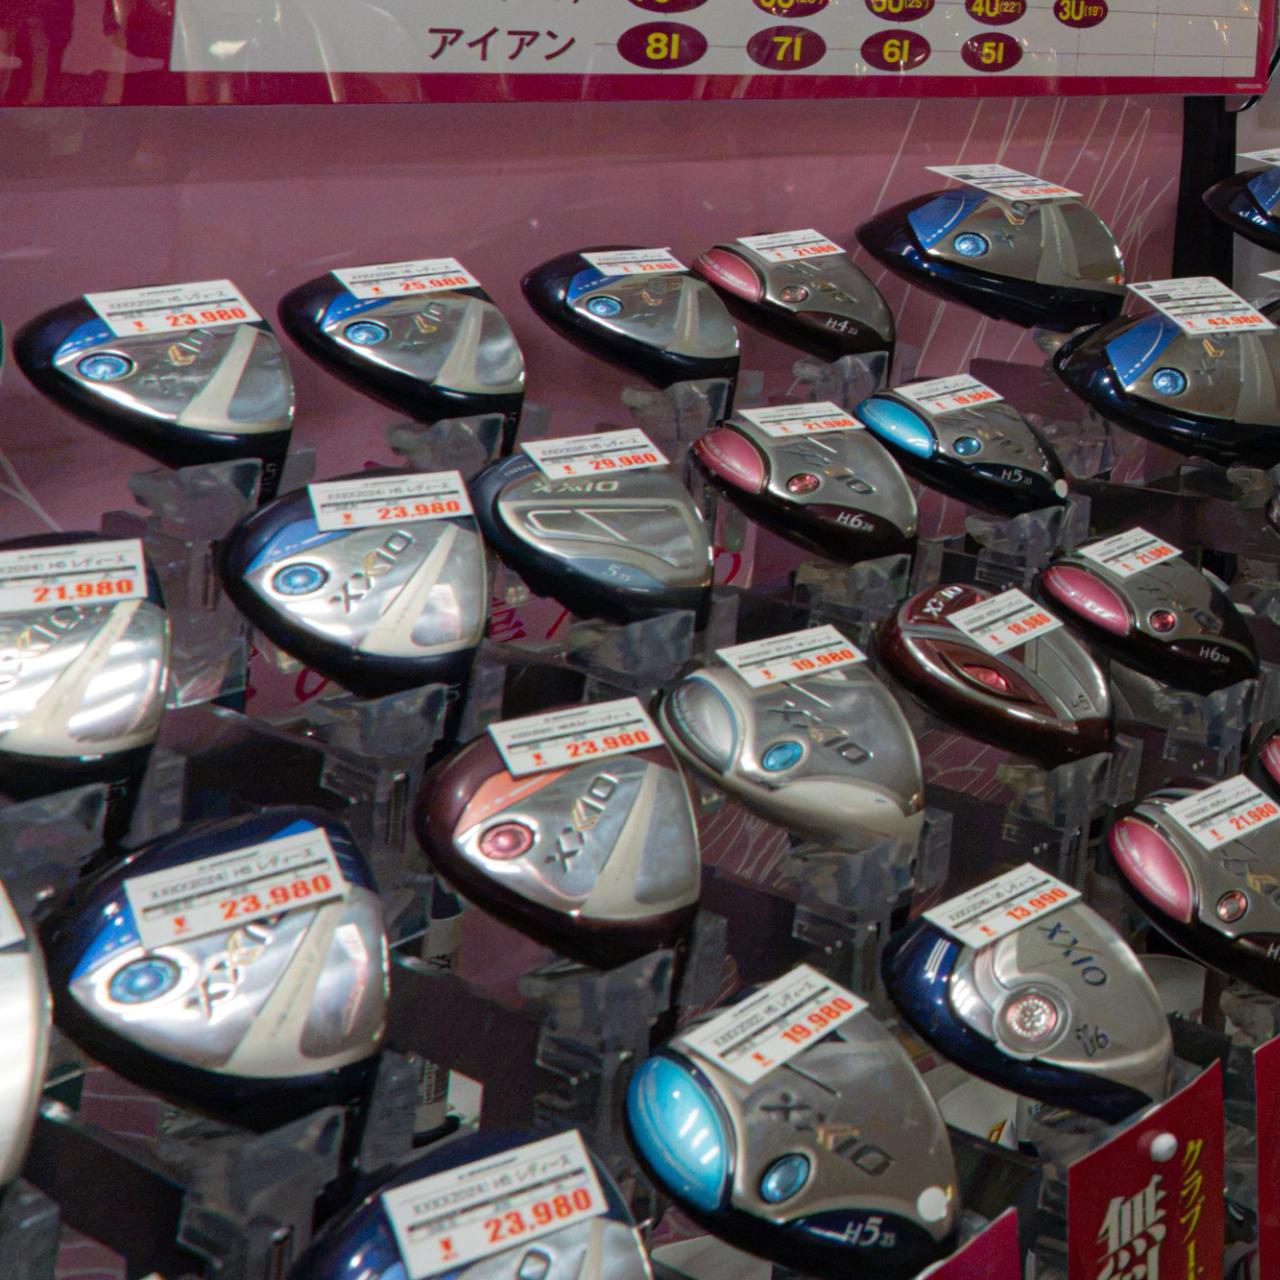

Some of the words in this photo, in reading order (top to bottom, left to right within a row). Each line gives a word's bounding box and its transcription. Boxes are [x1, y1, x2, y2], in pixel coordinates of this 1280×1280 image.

[426, 26, 577, 62] アイアン
[165, 306, 247, 328] 23,980
[827, 316, 849, 332] H4
[1001, 468, 1023, 483] H5
[377, 499, 462, 522] 23,980
[838, 511, 862, 528] H6
[33, 579, 134, 604] 21,980
[1200, 646, 1220, 660] H6
[565, 729, 651, 760] 23,980
[1230, 803, 1278, 831] 21,980
[220, 873, 332, 922] 23,980
[782, 997, 855, 1045] 19,980
[484, 1187, 593, 1245] 23,980
[845, 1215, 882, 1248] H5
